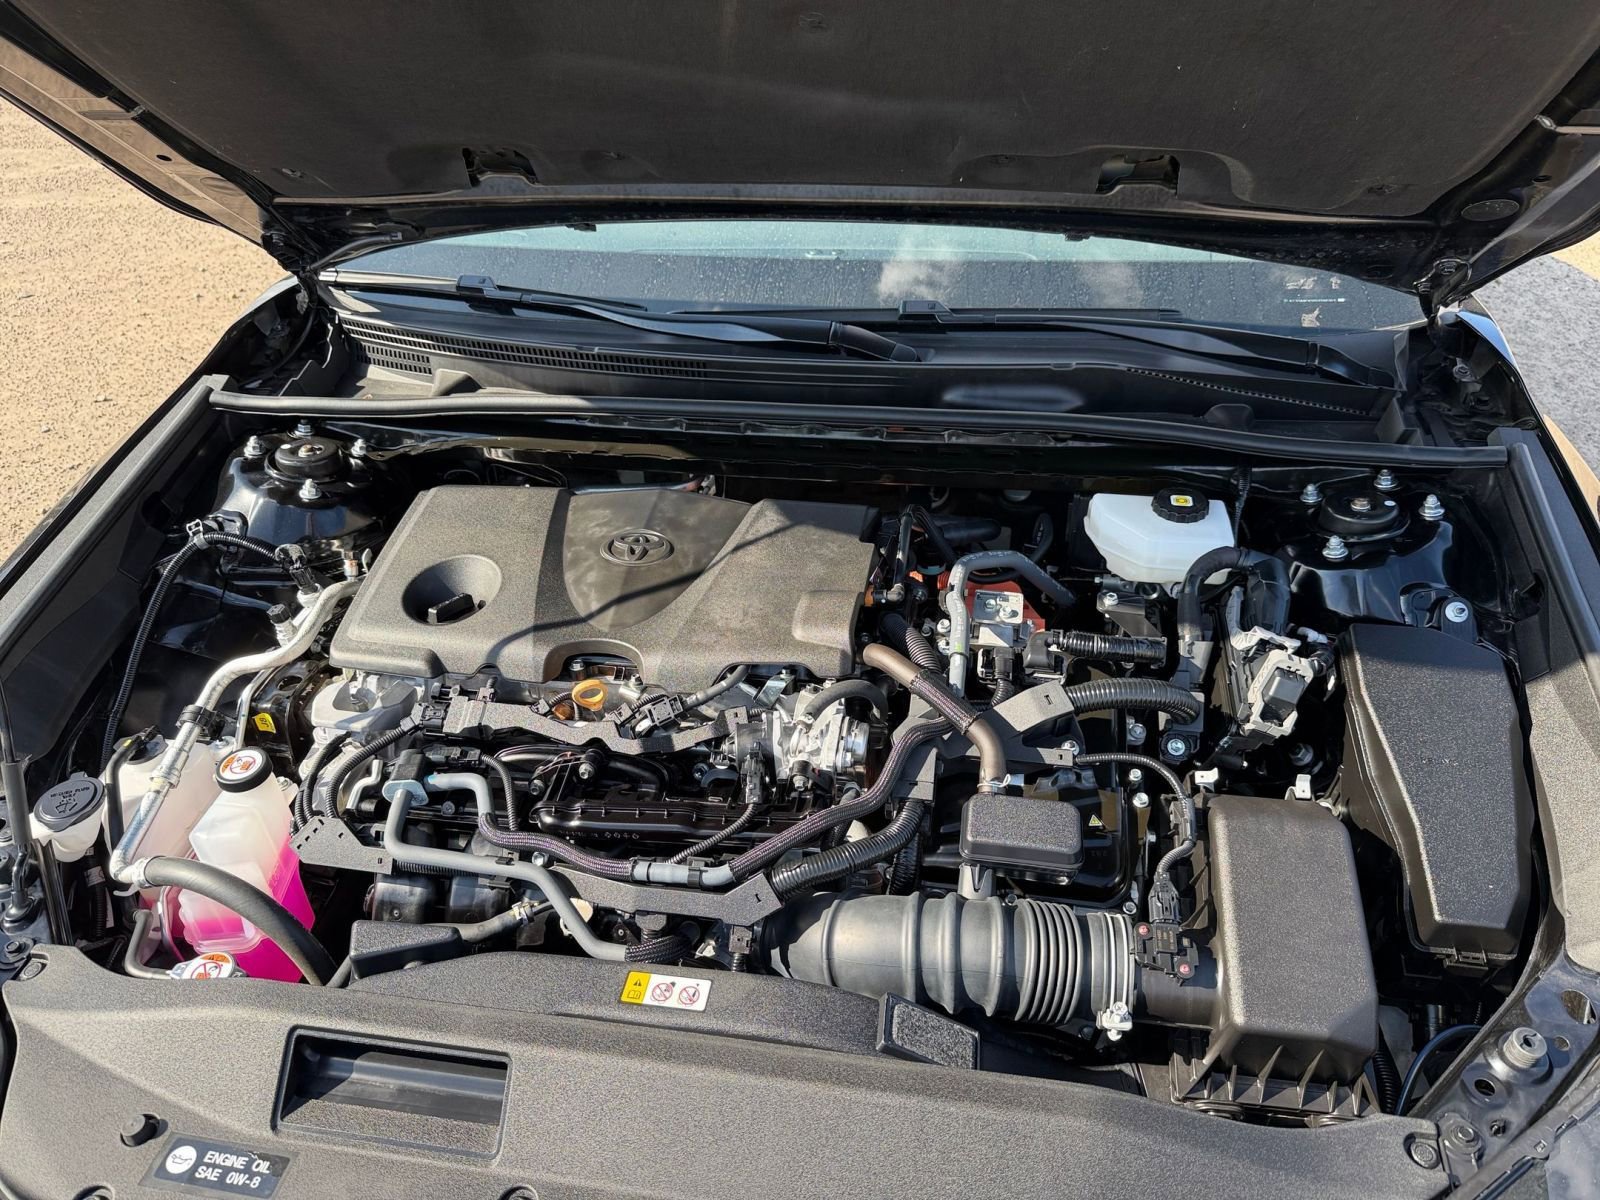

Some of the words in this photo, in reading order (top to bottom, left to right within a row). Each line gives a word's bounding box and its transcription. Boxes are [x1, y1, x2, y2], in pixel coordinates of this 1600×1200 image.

[203, 1151, 249, 1169] ENGINE
[252, 1159, 271, 1174] OIL
[195, 1166, 222, 1181] SAE
[226, 1172, 261, 1188] 0W-8
